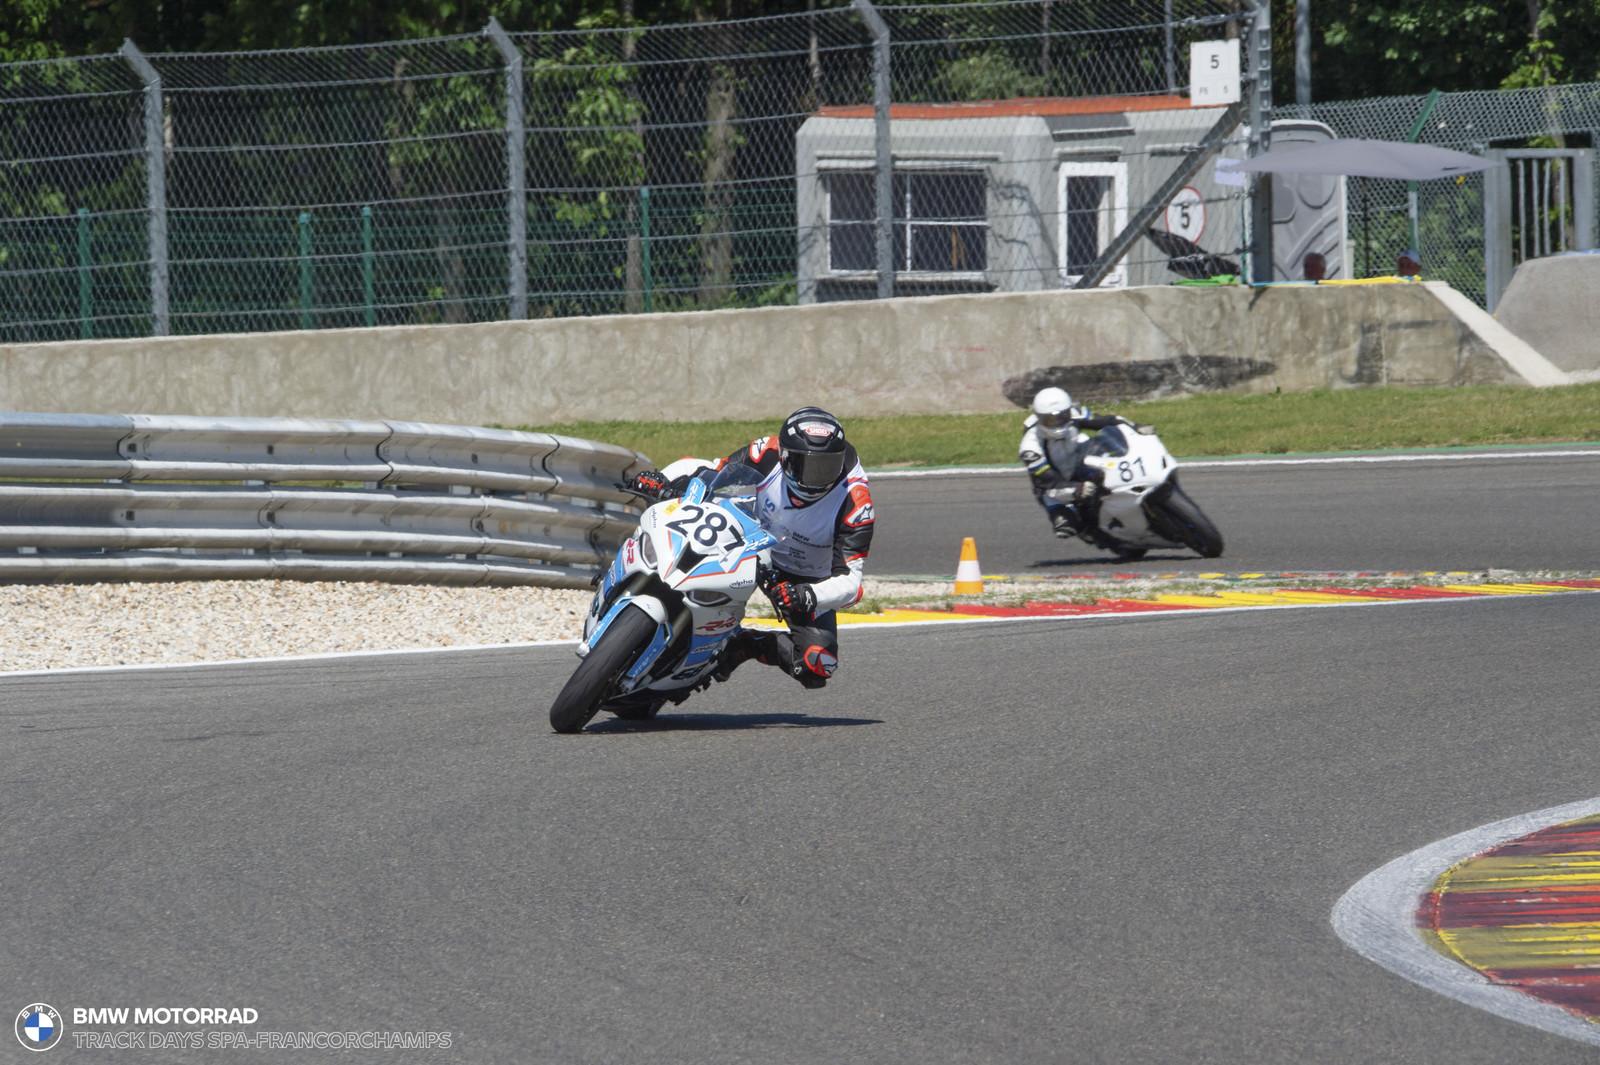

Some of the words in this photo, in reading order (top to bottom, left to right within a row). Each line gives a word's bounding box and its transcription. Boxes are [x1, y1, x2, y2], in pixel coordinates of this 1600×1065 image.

[1210, 54, 1220, 69] 5
[1181, 204, 1190, 229] 5
[1118, 456, 1146, 482] 81
[664, 505, 746, 552] 287
[731, 579, 754, 587] alpha
